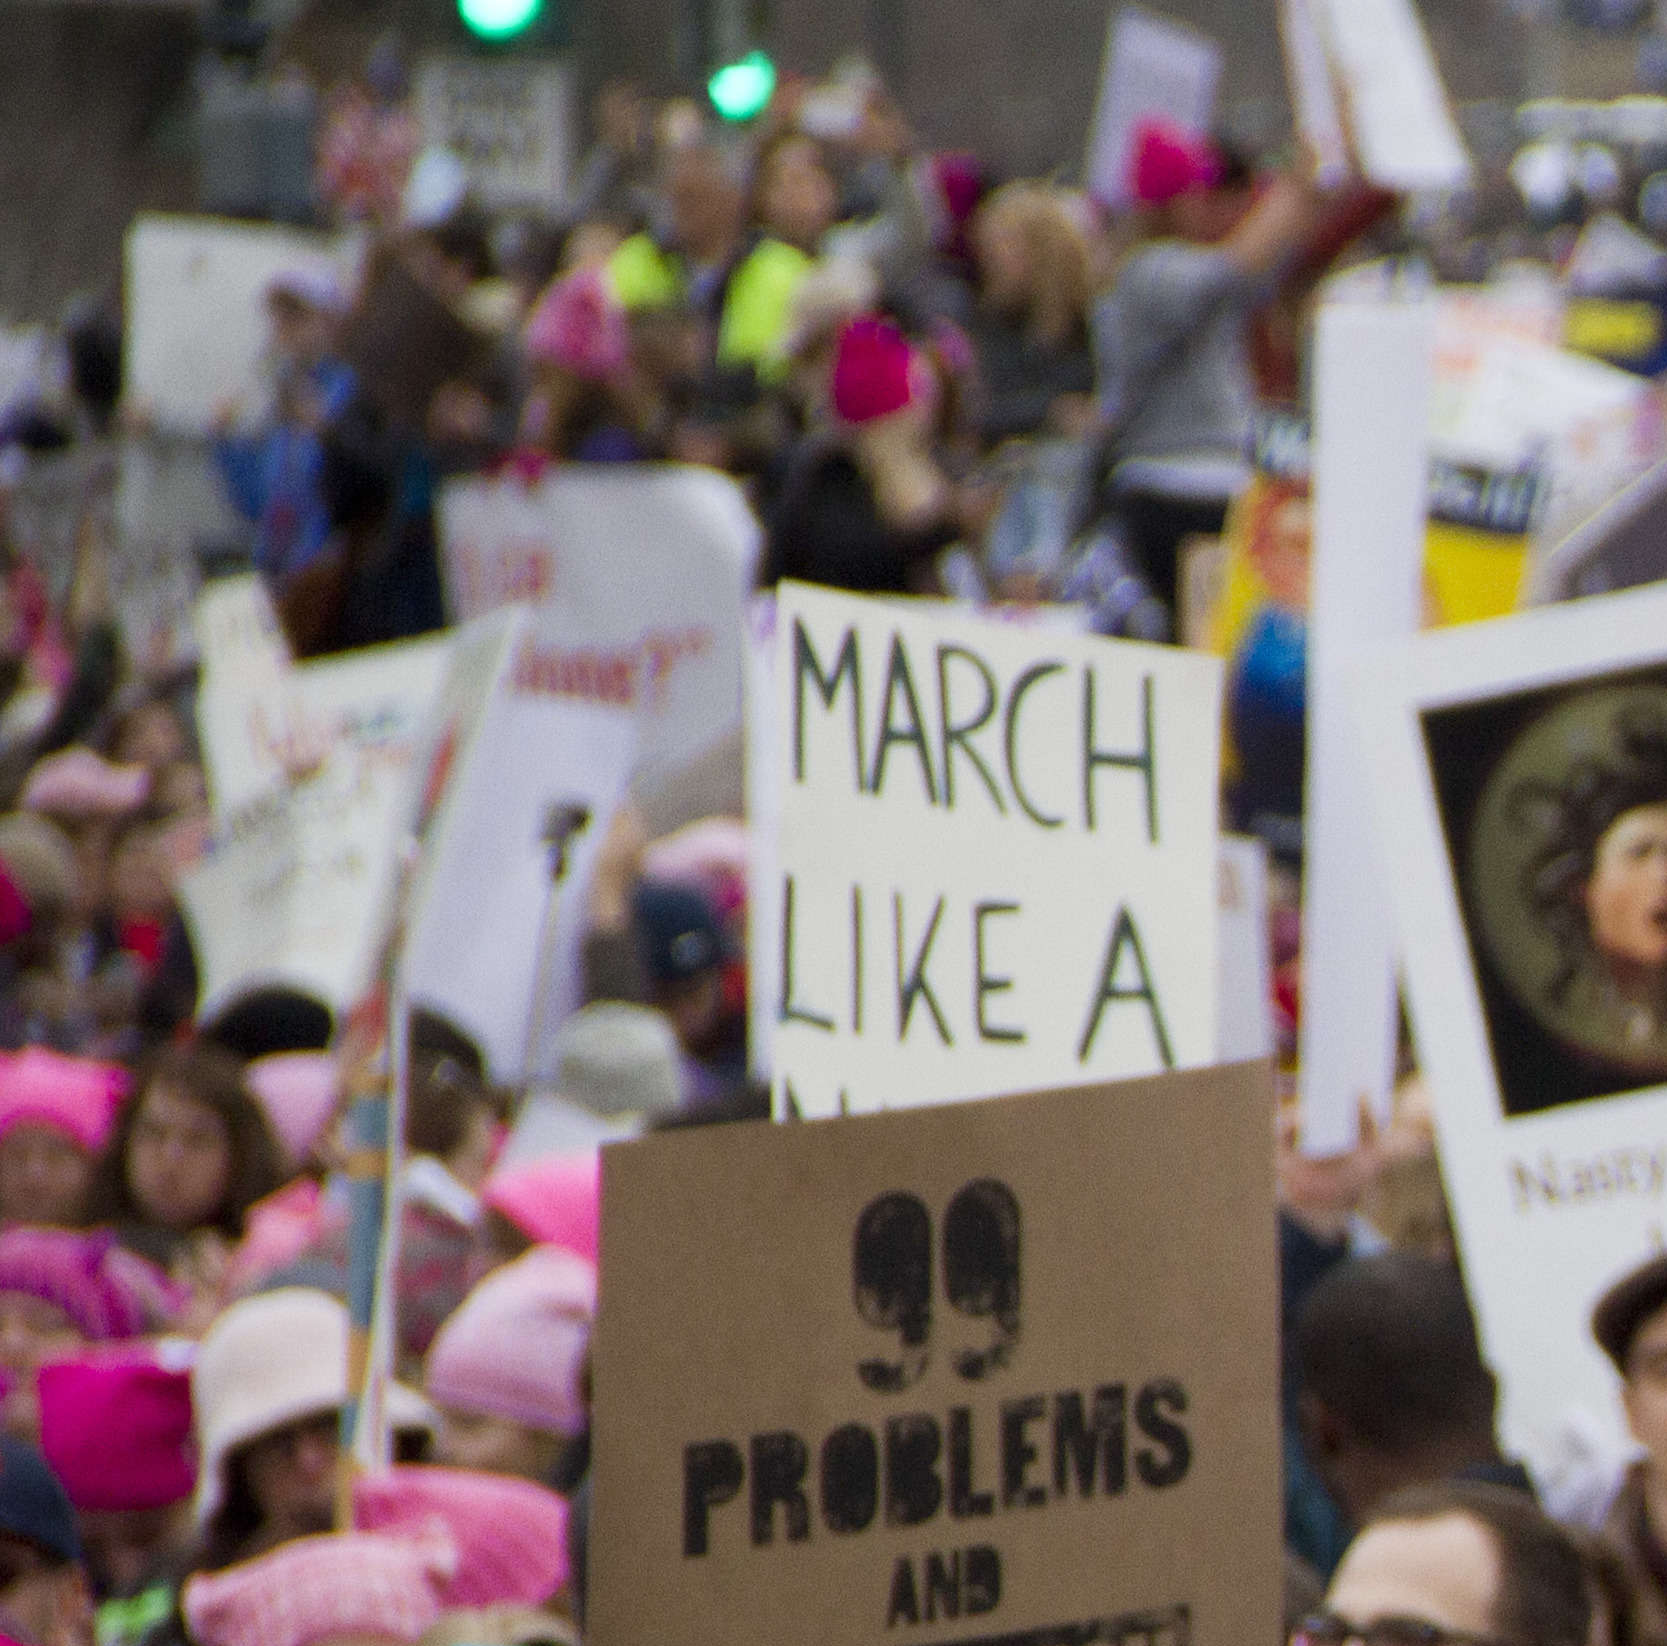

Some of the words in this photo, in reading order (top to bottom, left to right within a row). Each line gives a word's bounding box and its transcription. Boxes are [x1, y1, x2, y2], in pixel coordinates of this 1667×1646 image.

[794, 616, 1159, 845] MARCH
[780, 873, 1027, 1047] LIKE
[1079, 904, 1174, 1069] A
[852, 1178, 1022, 1394] 99
[683, 1378, 1192, 1558] PROBLEMS
[886, 1542, 1003, 1628] AND
